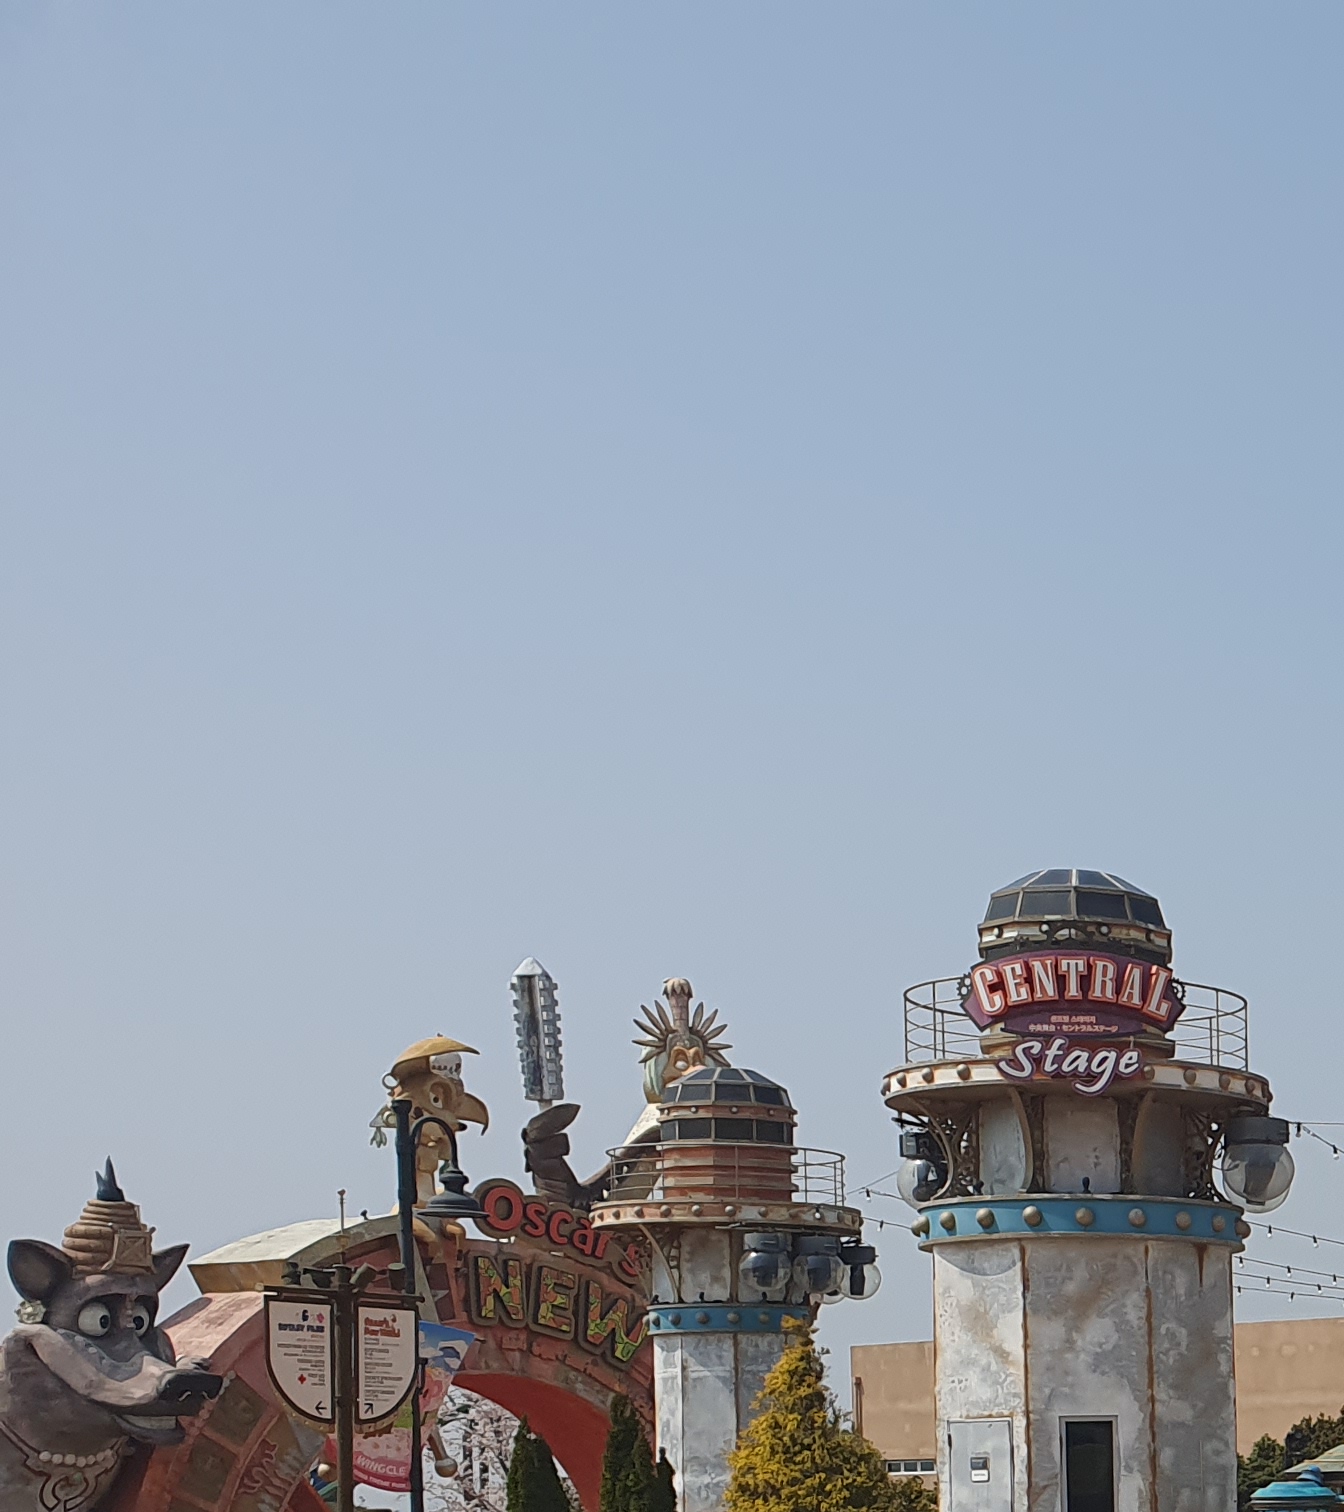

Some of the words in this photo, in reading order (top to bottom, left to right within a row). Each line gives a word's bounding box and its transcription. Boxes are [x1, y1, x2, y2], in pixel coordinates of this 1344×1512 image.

[972, 956, 1173, 1021] CENTRAL
[998, 1037, 1139, 1093] Stage
[484, 1186, 643, 1277] Oscars
[477, 1256, 650, 1362] NEW
[357, 1455, 407, 1475] WINGCLE
